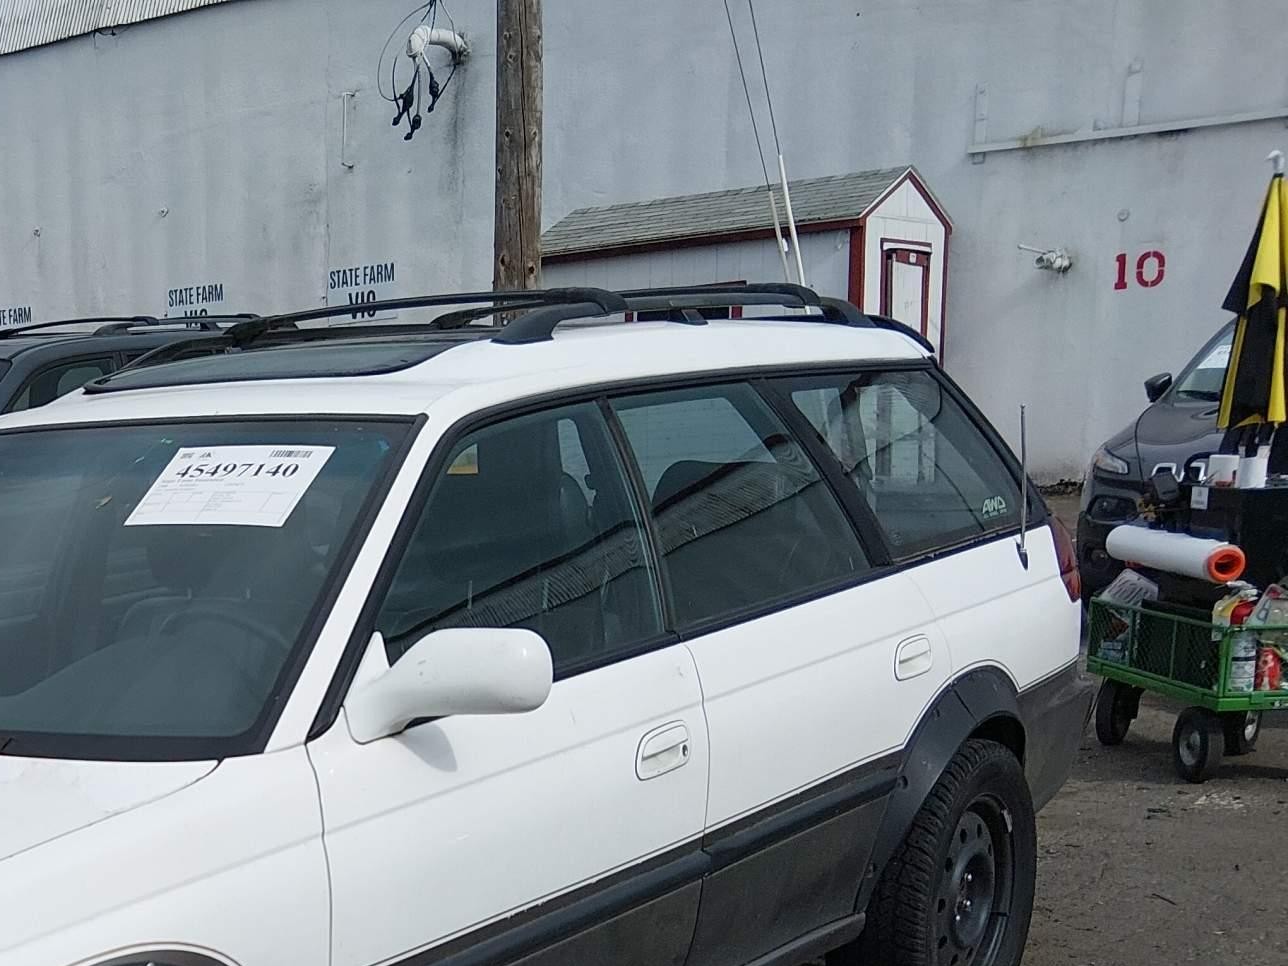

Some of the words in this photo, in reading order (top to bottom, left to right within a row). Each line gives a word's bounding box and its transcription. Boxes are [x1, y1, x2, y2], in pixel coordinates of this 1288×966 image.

[329, 267, 360, 290] STATE
[362, 262, 395, 286] FARM
[1114, 250, 1165, 290] 10
[168, 287, 194, 307] STATE
[196, 283, 224, 304] FARM
[8, 306, 32, 324] FARM
[176, 463, 299, 478] 45497140
[982, 495, 1006, 514] AWD
